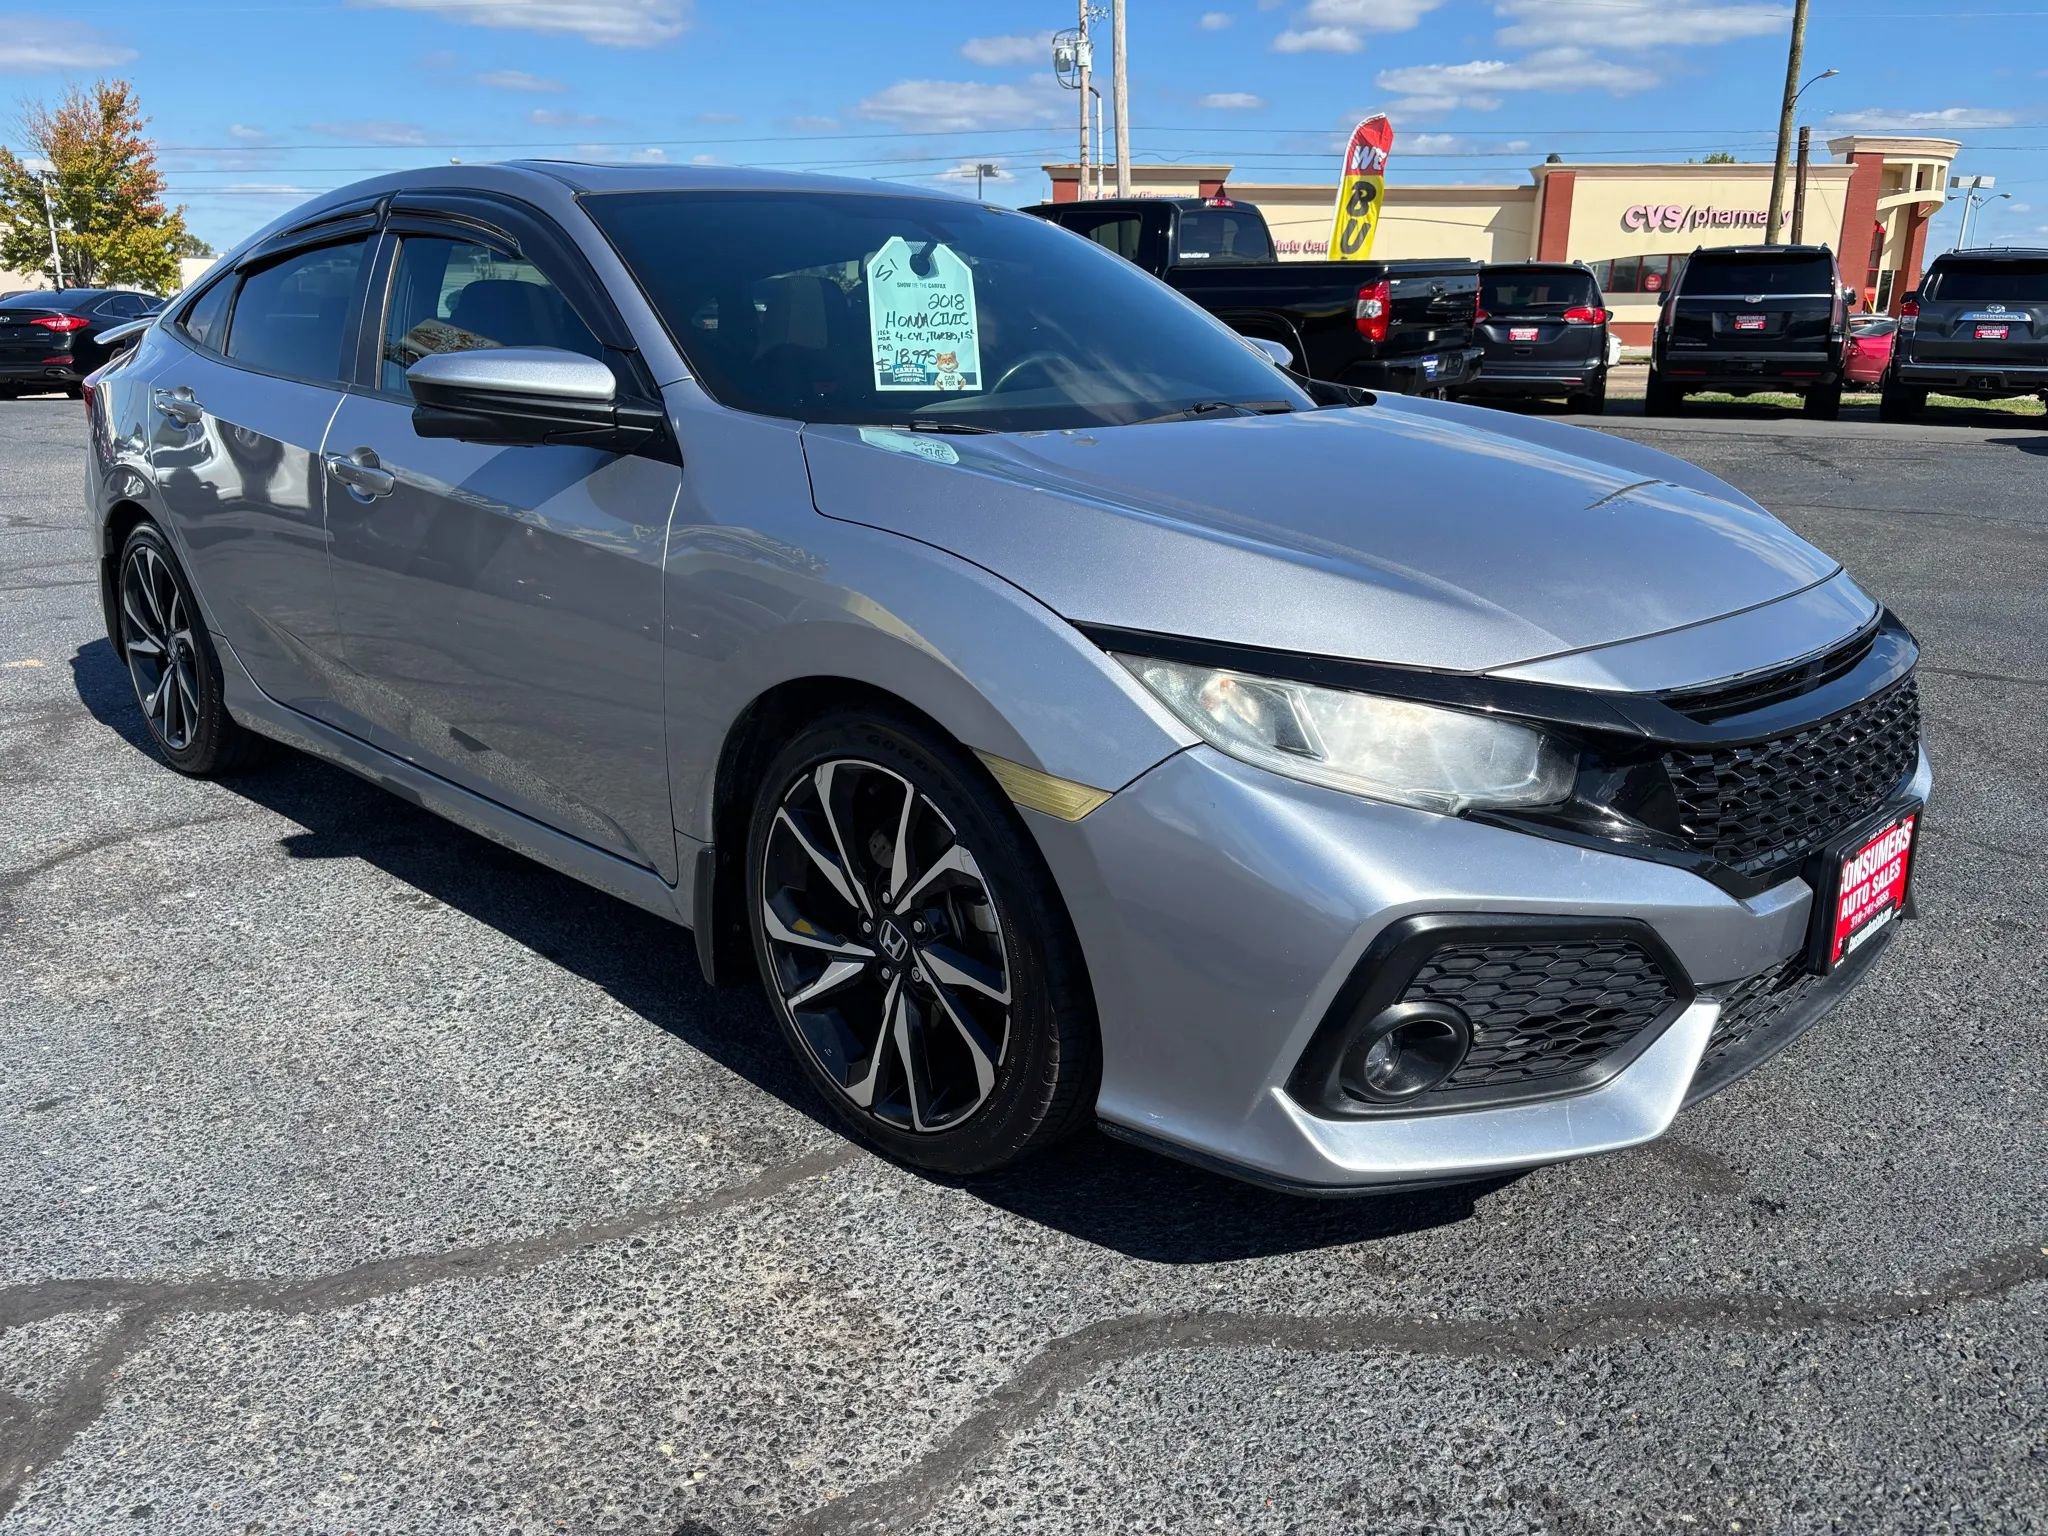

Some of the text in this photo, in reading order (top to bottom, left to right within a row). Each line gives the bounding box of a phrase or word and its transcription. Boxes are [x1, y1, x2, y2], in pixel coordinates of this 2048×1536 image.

[1351, 145, 1388, 171] WE
[1340, 181, 1377, 260] BU
[1624, 204, 1793, 232] CVS/pharmay
[928, 293, 965, 310] 2018
[885, 311, 969, 328] HONDA CIVIC
[875, 358, 892, 372] $
[1840, 857, 1901, 922] AUTO SALES
